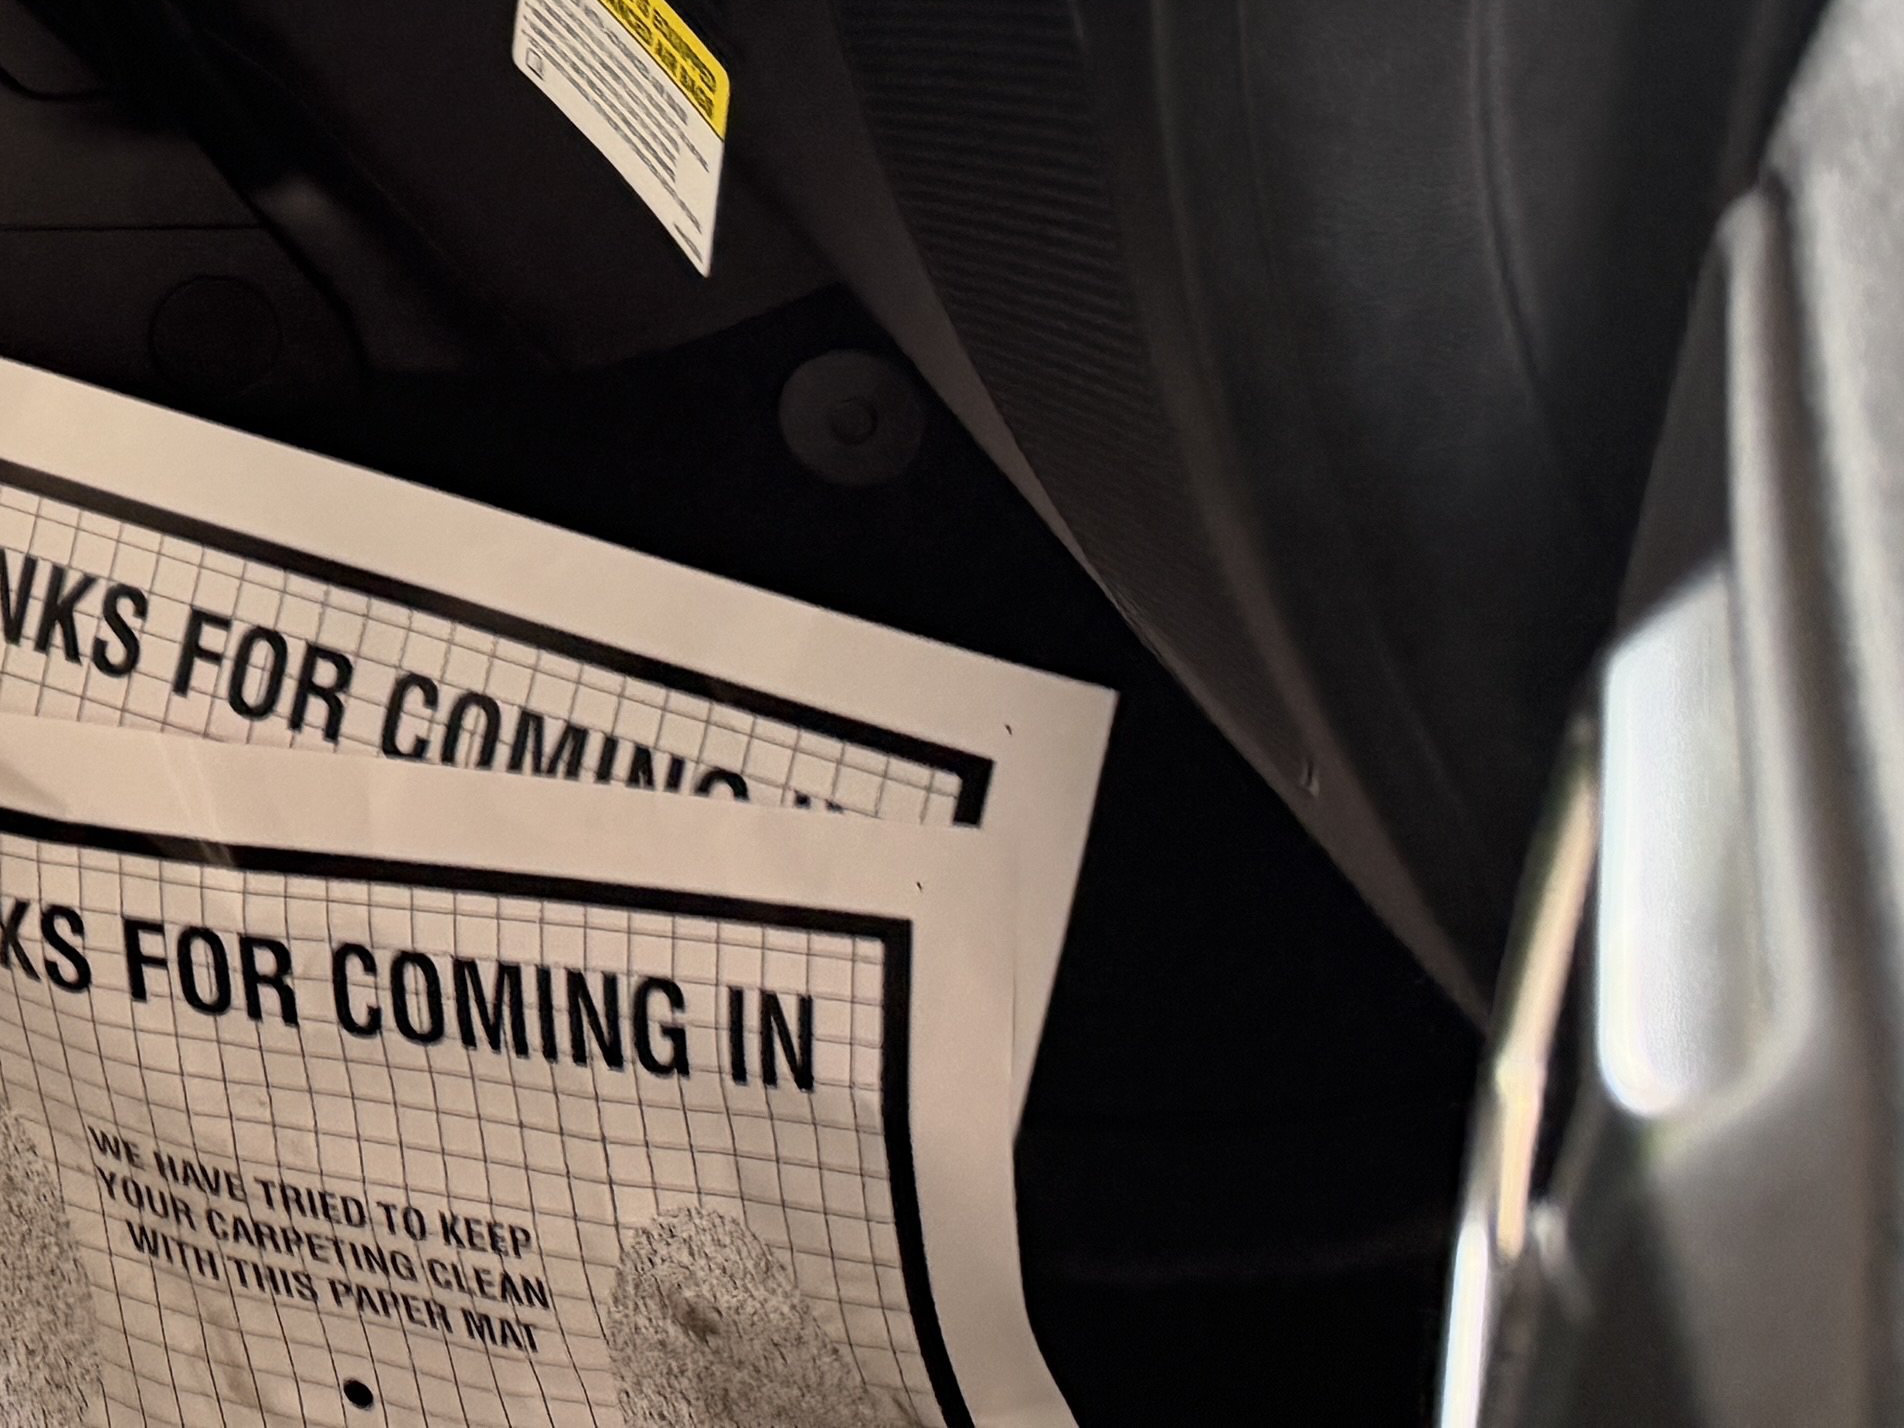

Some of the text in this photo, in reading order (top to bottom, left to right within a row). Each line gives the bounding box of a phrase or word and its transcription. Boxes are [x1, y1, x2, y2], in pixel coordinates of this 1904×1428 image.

[174, 603, 354, 742] FOR
[123, 916, 300, 1026] FOR
[332, 942, 691, 1078] COMING
[728, 985, 814, 1092] IN
[88, 1126, 531, 1258] WE HAVE TRIED TO KEEP
[95, 1166, 549, 1310] YOUR CARPETING CLEAN
[125, 1220, 538, 1353] WITH THIS PAPER MAT
